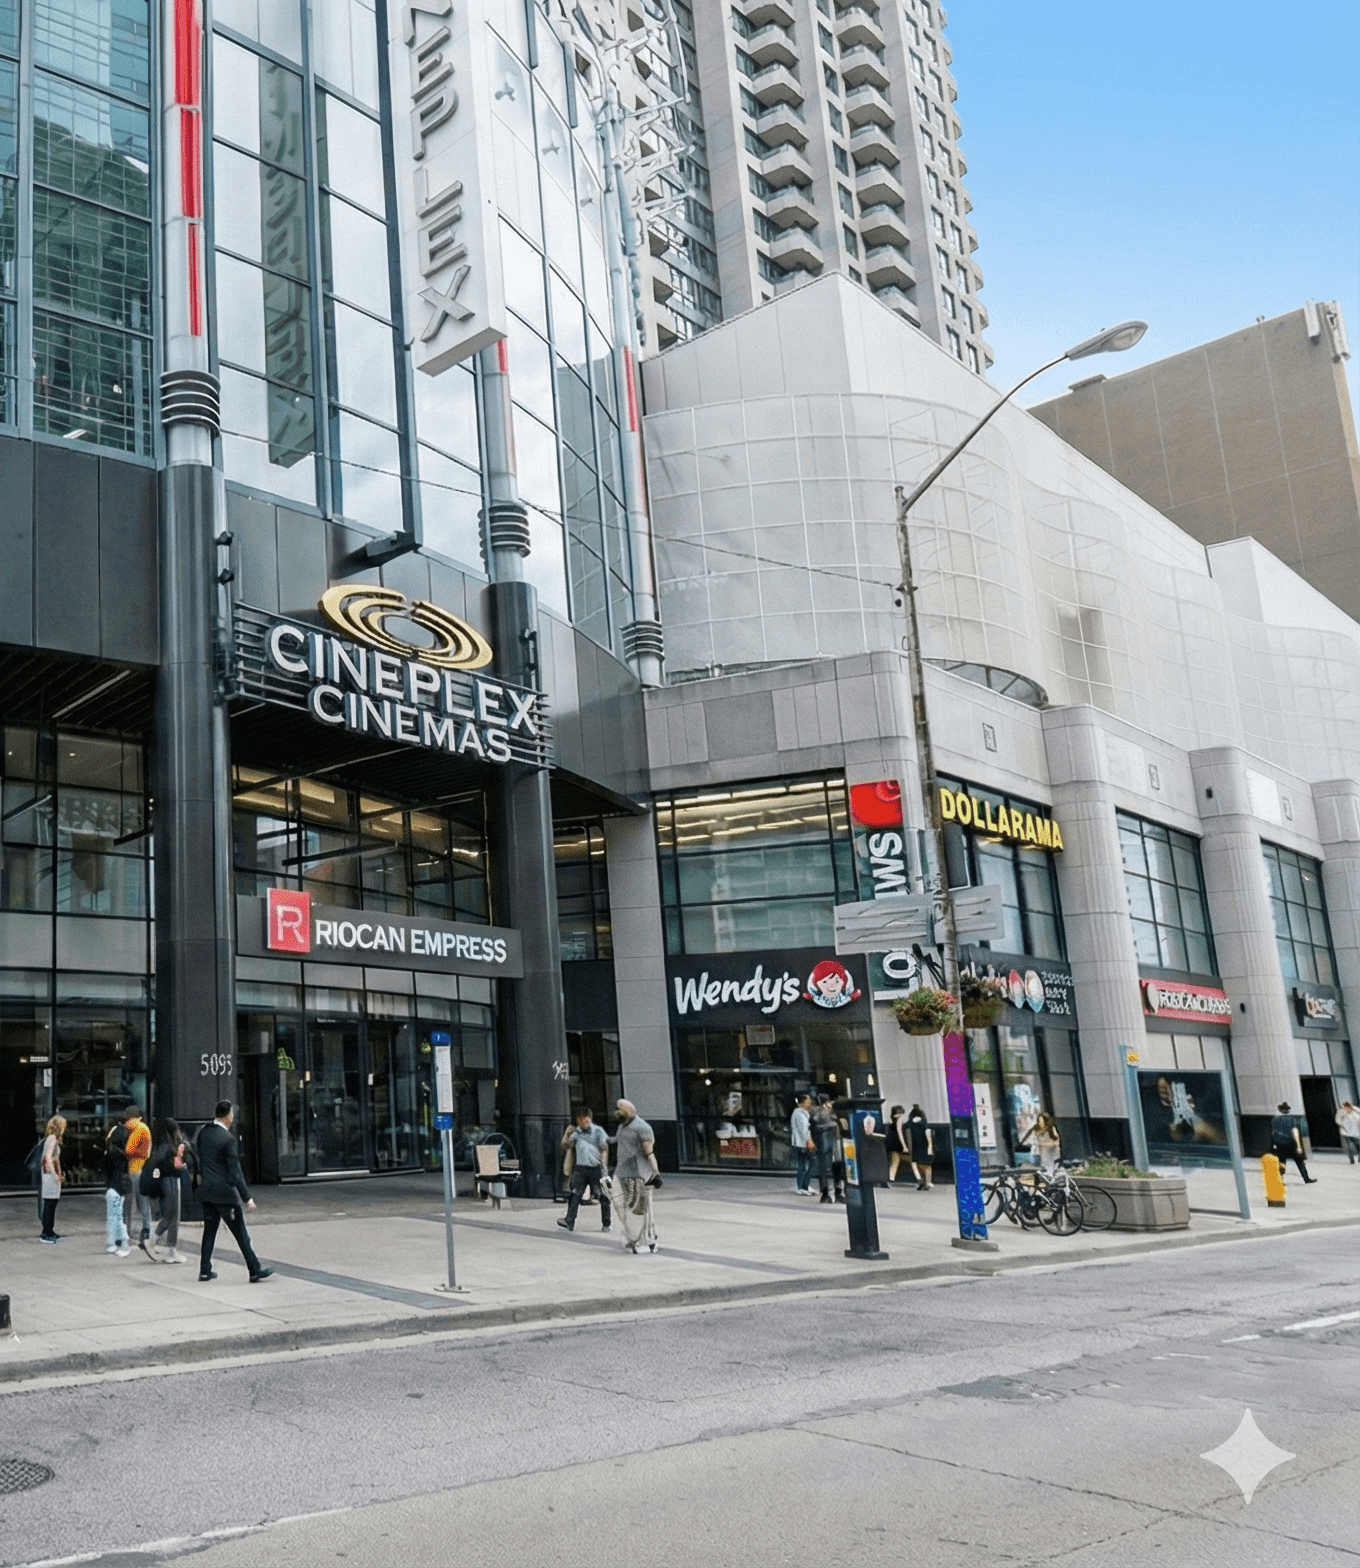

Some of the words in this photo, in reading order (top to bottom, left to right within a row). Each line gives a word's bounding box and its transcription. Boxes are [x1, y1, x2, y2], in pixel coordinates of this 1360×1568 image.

[267, 624, 539, 736] CINEPLEX
[311, 683, 513, 764] CINEMAS
[939, 787, 1064, 851] DOLLARAMA
[314, 919, 406, 953] RIOCAN
[410, 929, 508, 964] EMPRESS
[868, 832, 918, 1001] LOWS
[674, 964, 801, 1015] Wendy's
